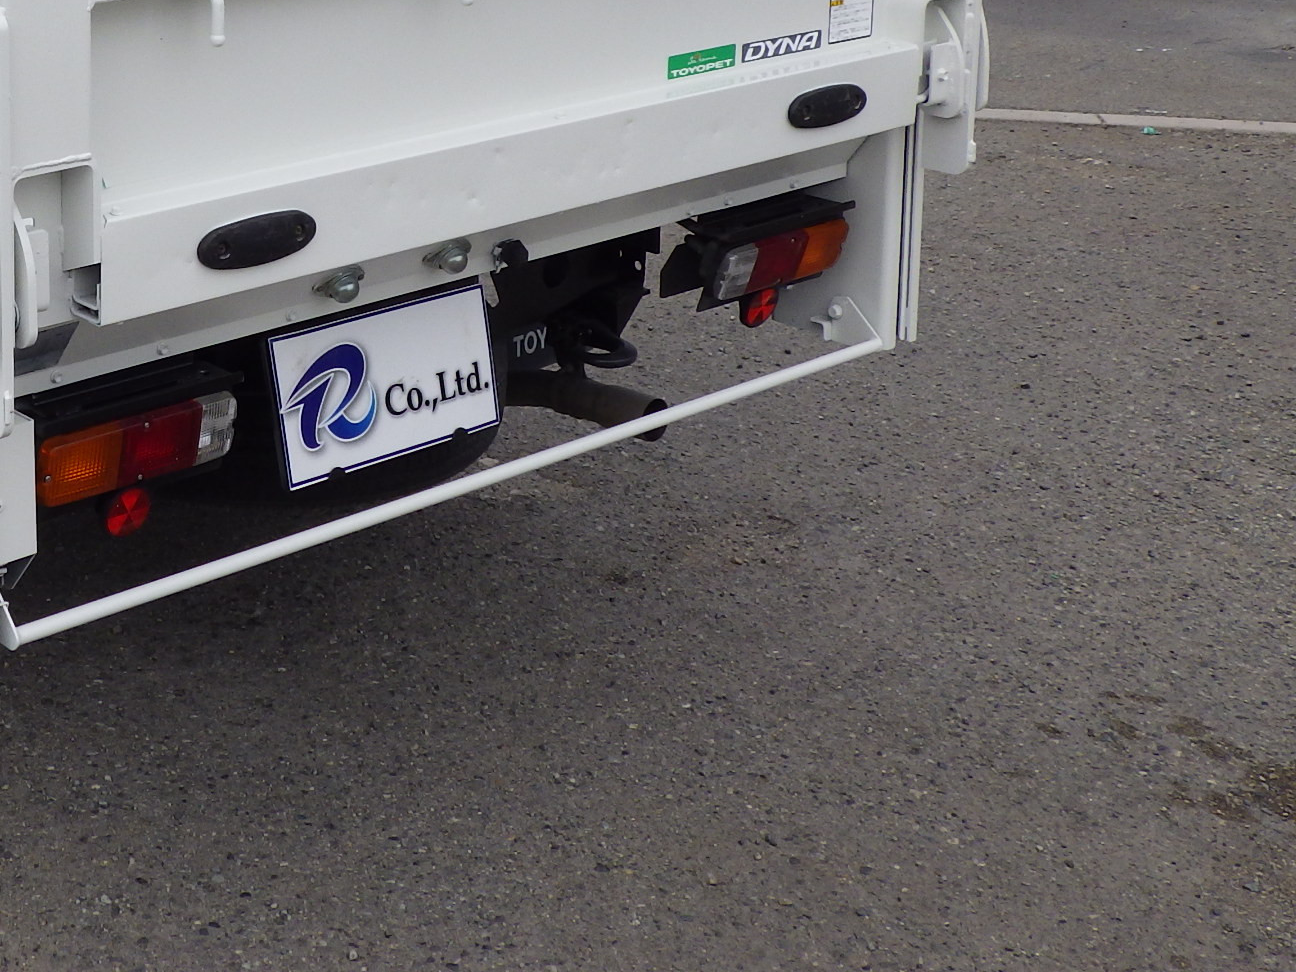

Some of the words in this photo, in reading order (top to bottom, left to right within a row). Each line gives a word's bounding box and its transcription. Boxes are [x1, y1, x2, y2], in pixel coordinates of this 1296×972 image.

[744, 31, 819, 63] DYNA
[670, 58, 734, 78] TOYOPET
[512, 327, 548, 358] TOY
[385, 361, 490, 417] Co.,Ltd.
